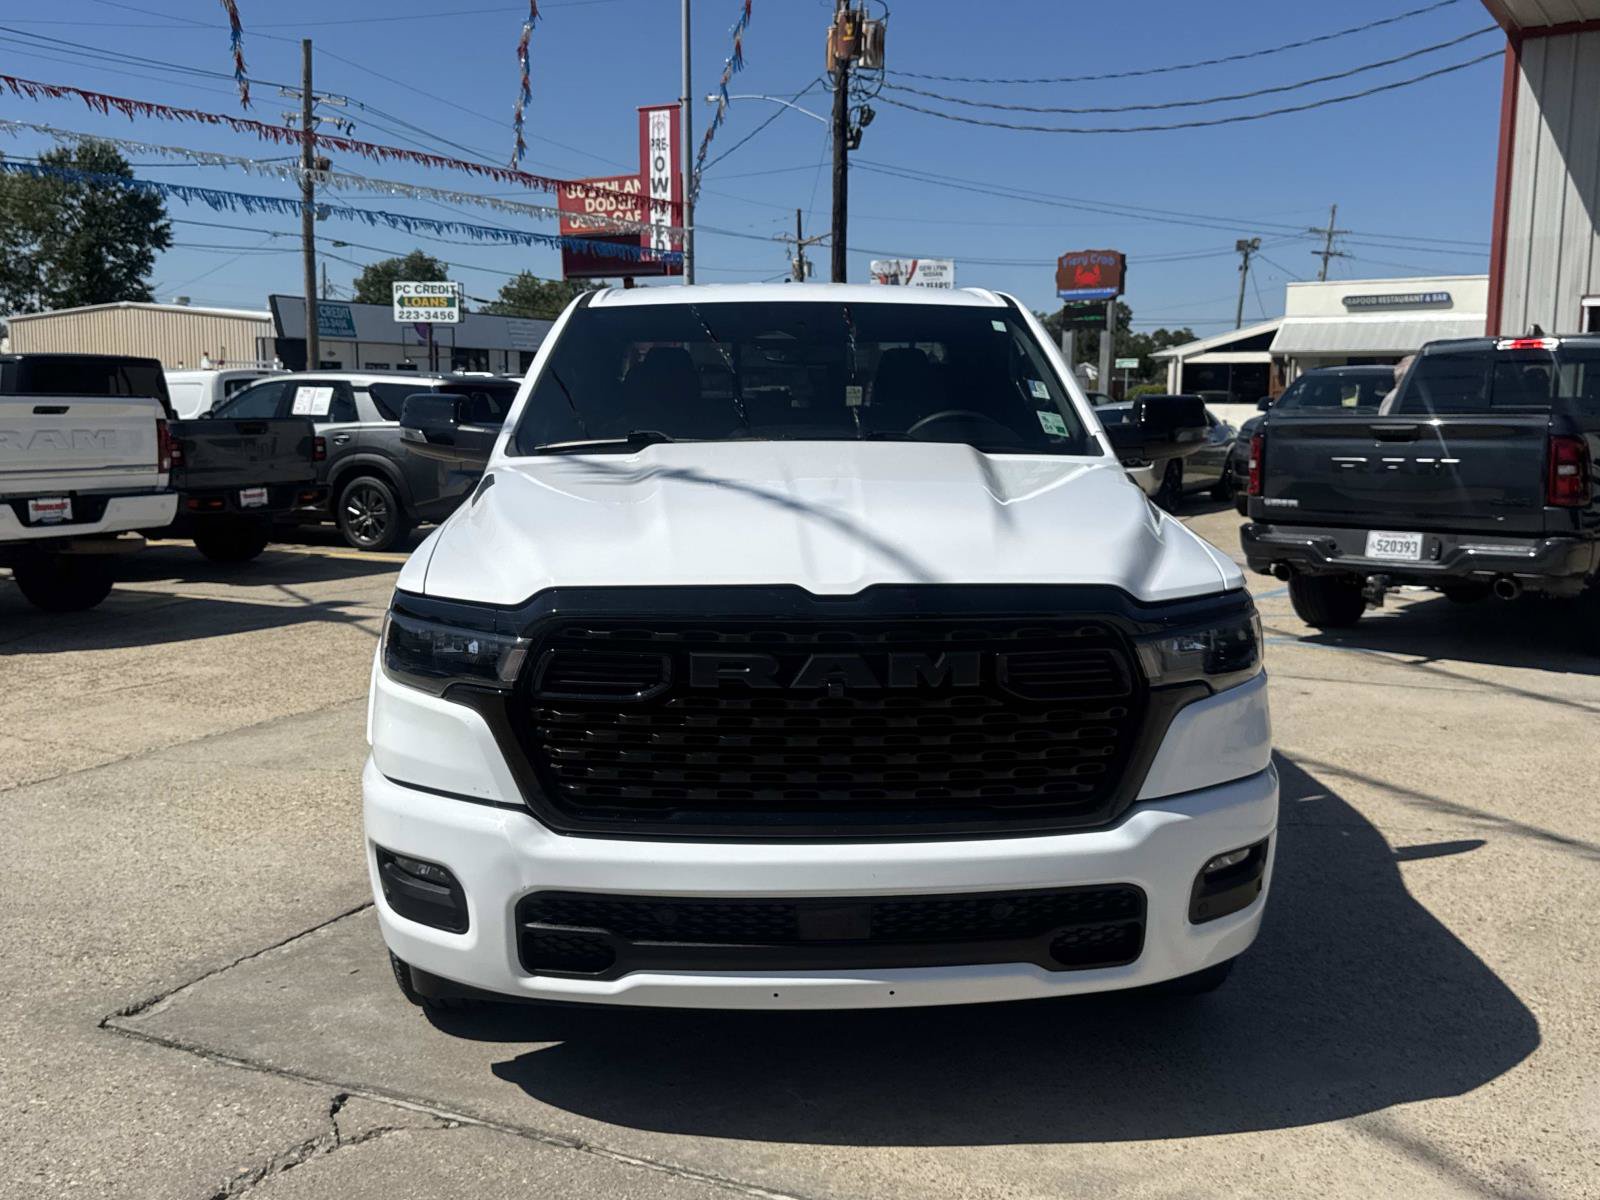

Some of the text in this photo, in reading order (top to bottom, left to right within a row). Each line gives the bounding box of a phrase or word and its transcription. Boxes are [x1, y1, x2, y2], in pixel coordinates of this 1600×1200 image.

[395, 284, 456, 294] PC CREDIT
[404, 297, 448, 307] LOANS
[398, 310, 455, 320] 223-3456
[1376, 539, 1418, 554] 520393
[689, 651, 980, 690] RAM
